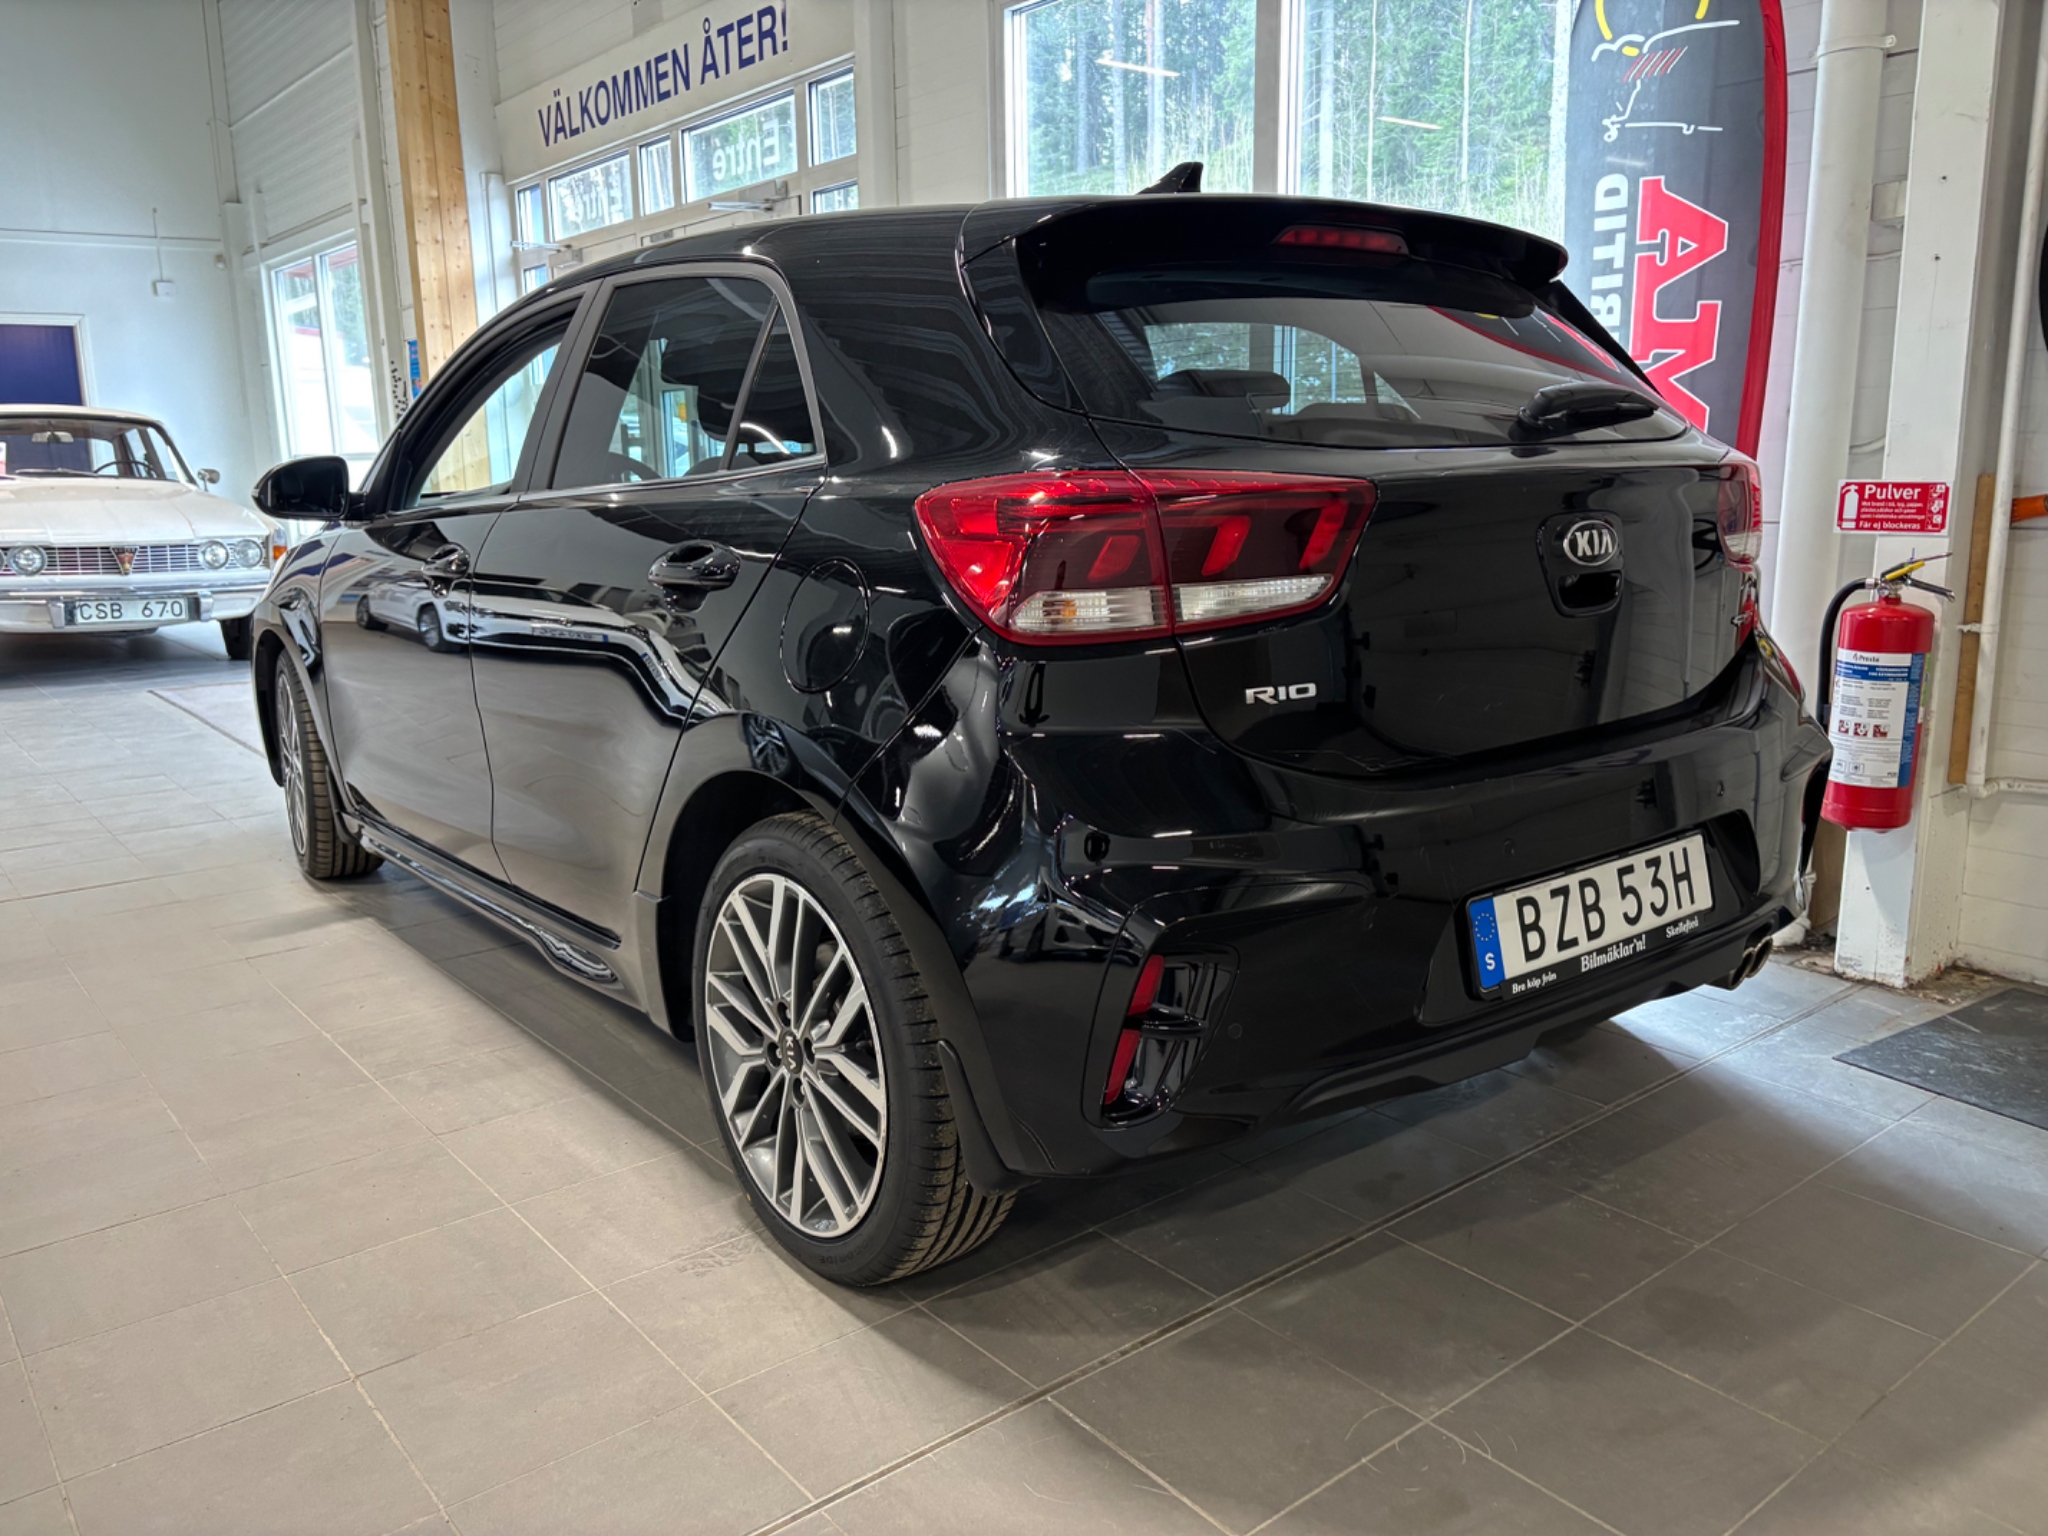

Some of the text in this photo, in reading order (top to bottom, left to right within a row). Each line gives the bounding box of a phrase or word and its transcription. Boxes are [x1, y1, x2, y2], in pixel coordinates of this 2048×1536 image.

[538, 0, 788, 147] VÄLKOMMEN ÅTER!
[1864, 483, 1922, 500] Pulver
[1859, 521, 1921, 530] Får ej blockeras
[1575, 529, 1613, 557] KIA
[79, 600, 183, 620] CSB 670
[1245, 682, 1317, 704] RIO
[1516, 847, 1695, 963] BZB 53H
[1485, 952, 1496, 971] S
[1512, 983, 1526, 994] Bra
[1527, 977, 1541, 989] köp
[785, 1036, 796, 1070] KIA
